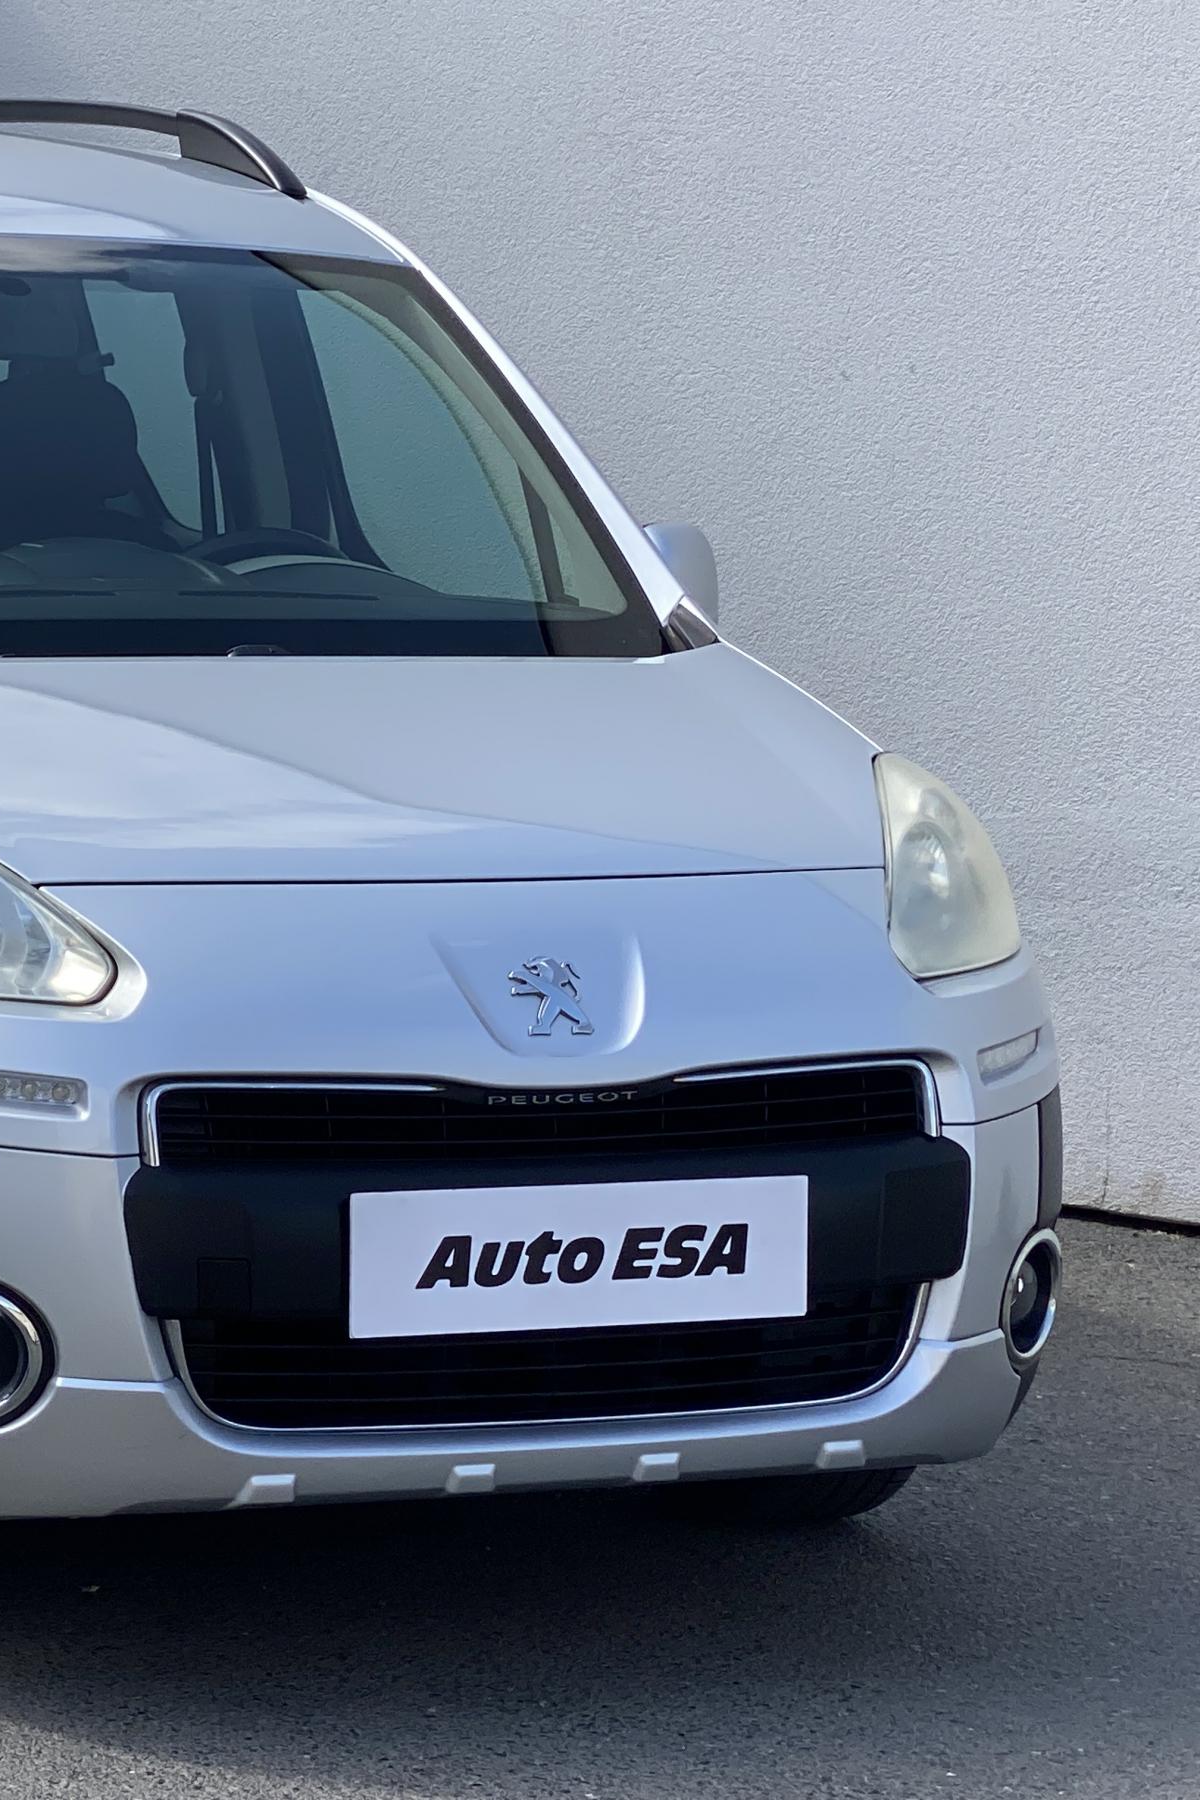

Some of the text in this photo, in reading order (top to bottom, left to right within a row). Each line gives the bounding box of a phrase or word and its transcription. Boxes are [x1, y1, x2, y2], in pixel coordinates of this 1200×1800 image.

[487, 1090, 639, 1106] PEUGEOT
[415, 1222, 749, 1290] Auto ESA
